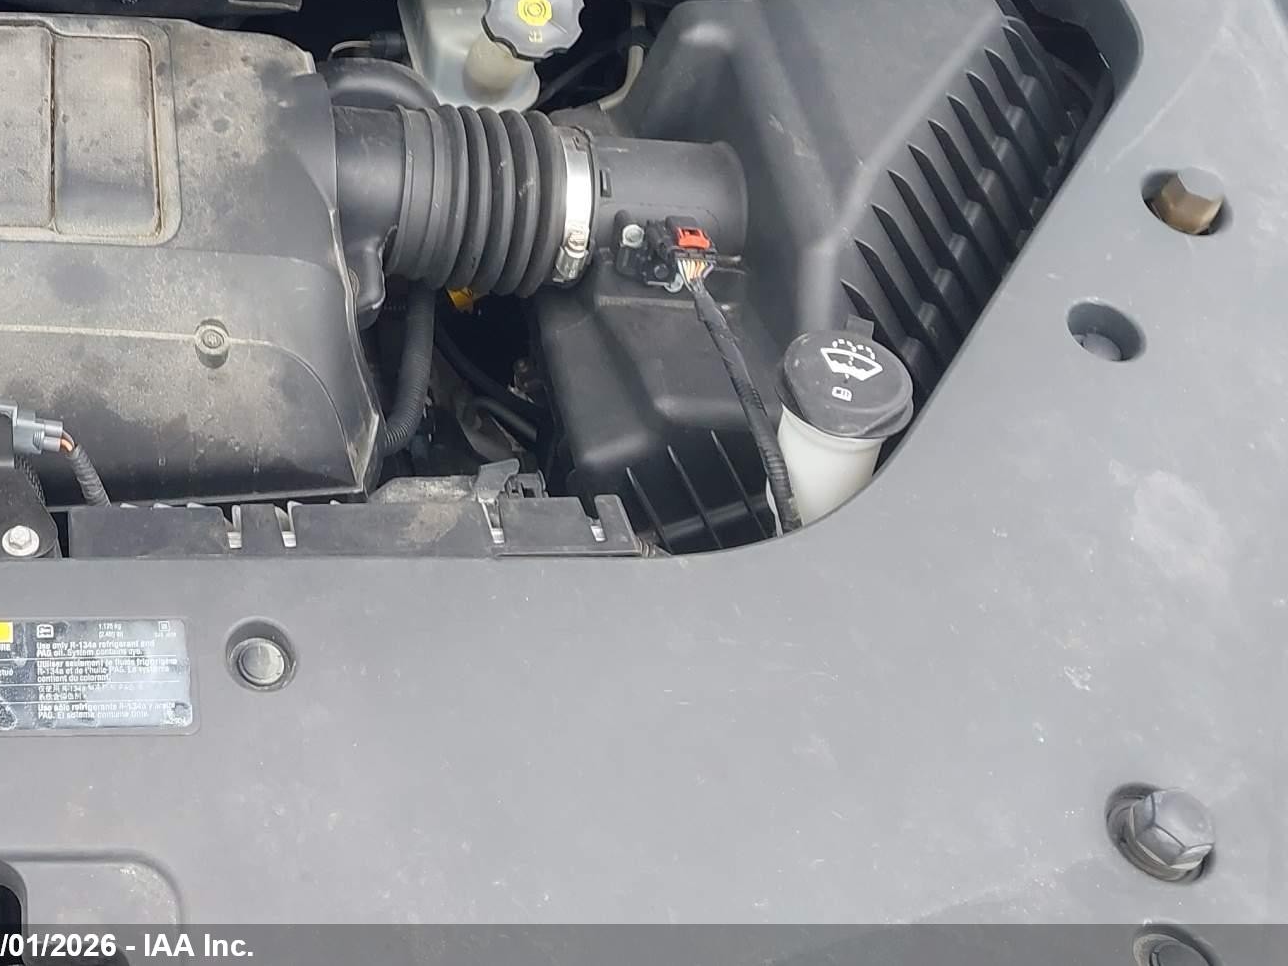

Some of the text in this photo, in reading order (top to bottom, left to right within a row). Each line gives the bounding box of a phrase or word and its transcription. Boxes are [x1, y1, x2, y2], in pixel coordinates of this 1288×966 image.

[36, 641, 51, 650] Use
[52, 641, 69, 650] only
[69, 641, 97, 649] R-134a
[98, 640, 139, 650] refrigerant
[36, 649, 52, 657] PAG
[67, 649, 94, 657] System
